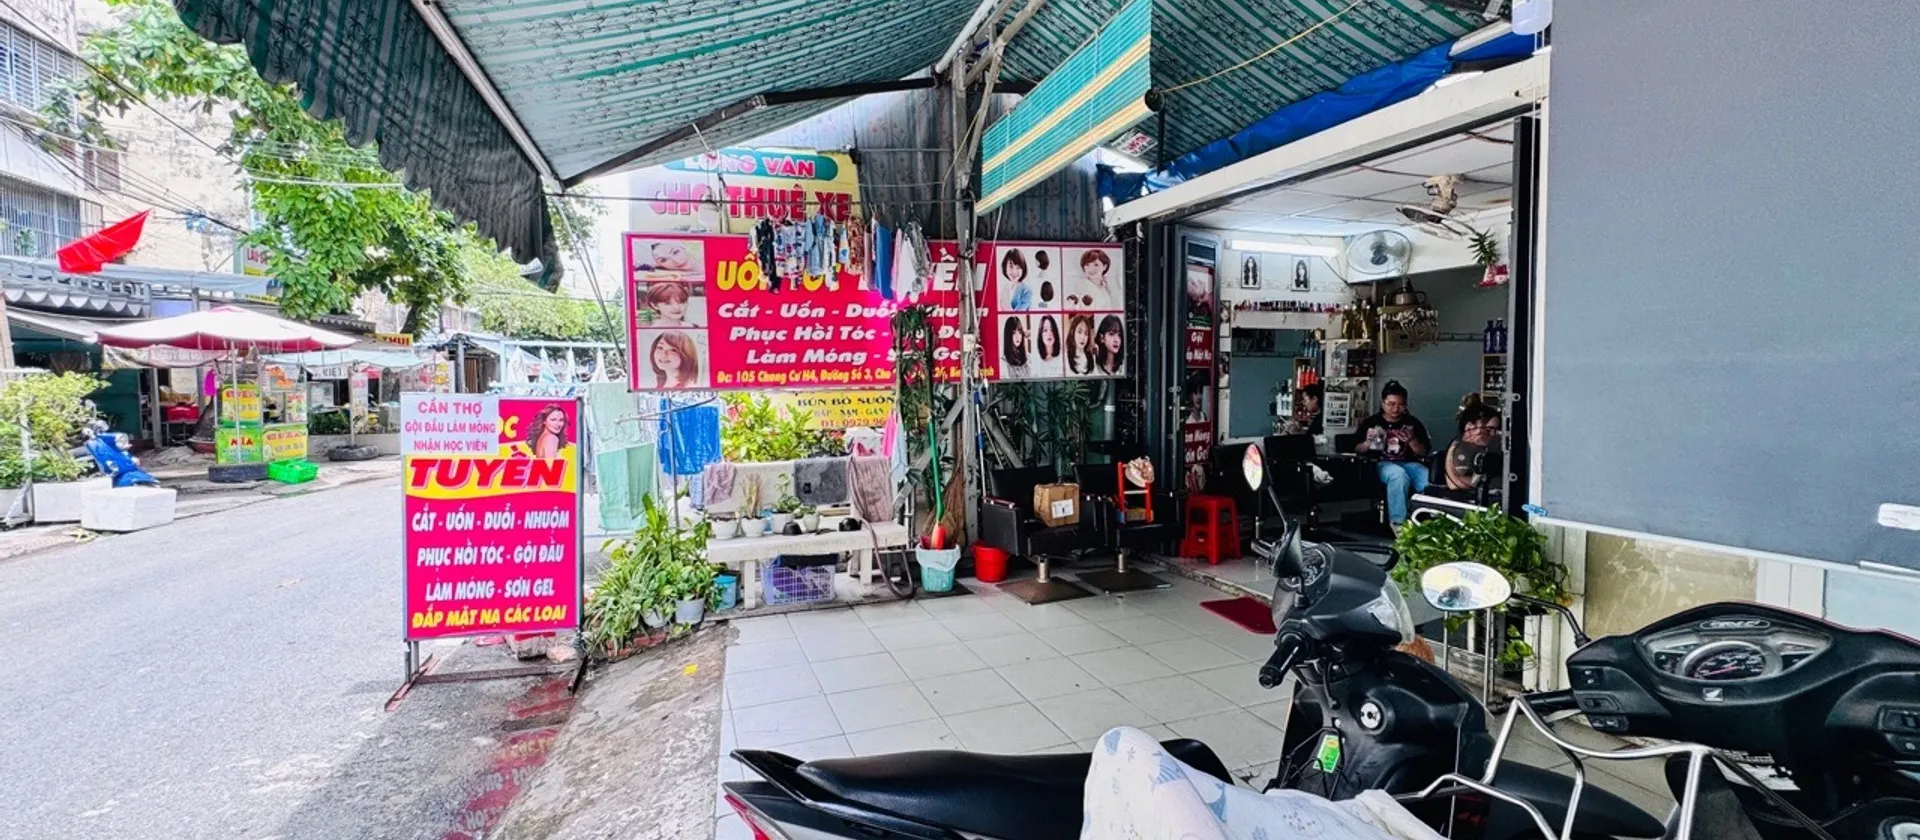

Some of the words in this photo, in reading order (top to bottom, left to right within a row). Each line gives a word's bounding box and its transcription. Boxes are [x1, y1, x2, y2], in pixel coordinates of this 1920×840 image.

[762, 155, 816, 179] VÂN
[727, 183, 807, 222] THUÊ
[815, 190, 853, 224] XE
[718, 300, 760, 318] Cắt
[780, 300, 825, 318] Uốn
[729, 326, 788, 345] Phục
[794, 323, 834, 340] Hồi
[839, 325, 876, 340] Tóc
[746, 348, 797, 364] Làm
[802, 347, 867, 366] Móng
[933, 347, 961, 361] Ge
[737, 370, 755, 383] 105
[453, 401, 483, 418] THỢ
[405, 419, 422, 435] GỘI
[424, 418, 444, 432] ĐẦU
[447, 420, 466, 433] LÀM
[469, 421, 496, 433] MÓNG
[414, 438, 440, 453] NHẬN
[443, 440, 463, 453] HỌC
[465, 438, 487, 451] VIÊN
[410, 445, 567, 489] TUYỀN
[412, 503, 436, 531] CẮT
[445, 503, 474, 531] UỐN
[524, 506, 570, 534] NHUỘM
[416, 547, 452, 572] PHỤC
[454, 538, 478, 566] HỒI
[480, 541, 505, 565] TÓC
[513, 540, 536, 568] GỘI
[538, 536, 564, 563] ĐẦU
[425, 577, 452, 602] LÀM
[455, 576, 495, 600] MÓNG
[504, 576, 531, 598] SƠN
[533, 577, 555, 597] GEL
[412, 604, 444, 628] ĐẮP
[446, 605, 478, 630] MẶT
[480, 608, 500, 628] NẠ
[504, 603, 532, 624] CÁC
[534, 604, 567, 624] LOẠI
